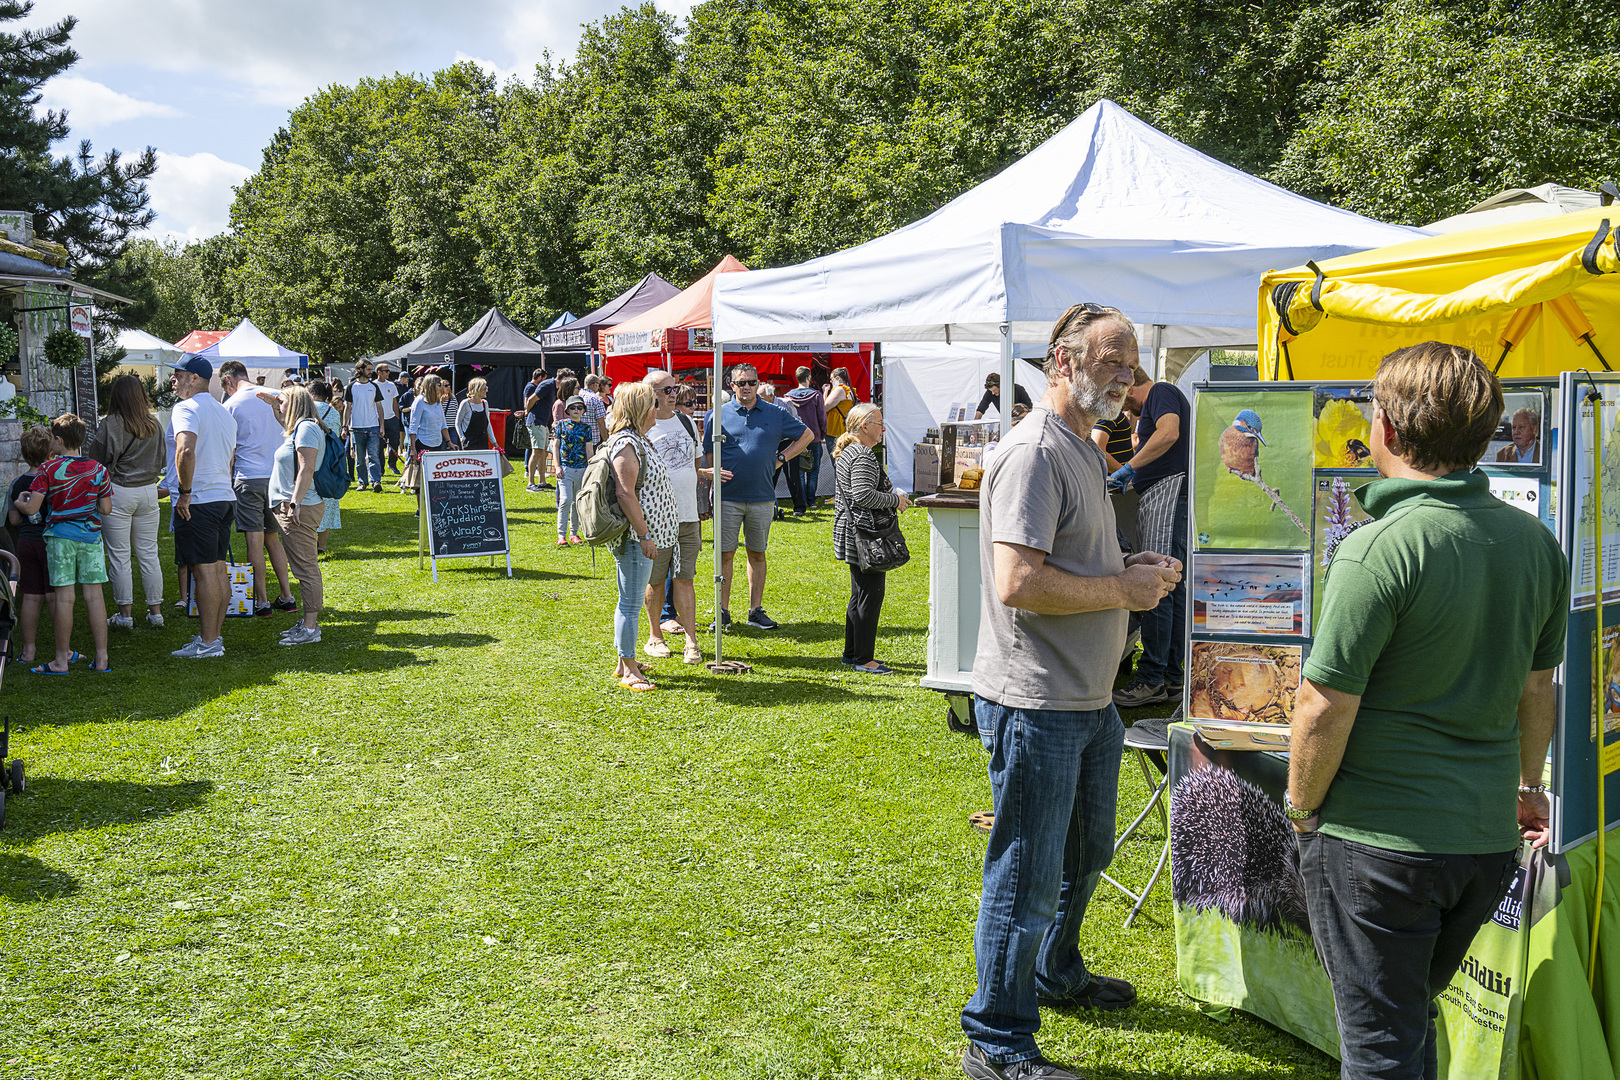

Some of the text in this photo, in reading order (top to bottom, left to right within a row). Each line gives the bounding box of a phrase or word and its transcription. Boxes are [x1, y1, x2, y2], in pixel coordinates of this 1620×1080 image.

[917, 445, 928, 455] Boo
[435, 458, 489, 470] COUNTRY
[432, 468, 493, 479] BUMPKINS
[448, 515, 486, 526] Pudding
[1440, 991, 1462, 1009] South
[1447, 984, 1506, 1021] orth East Some
